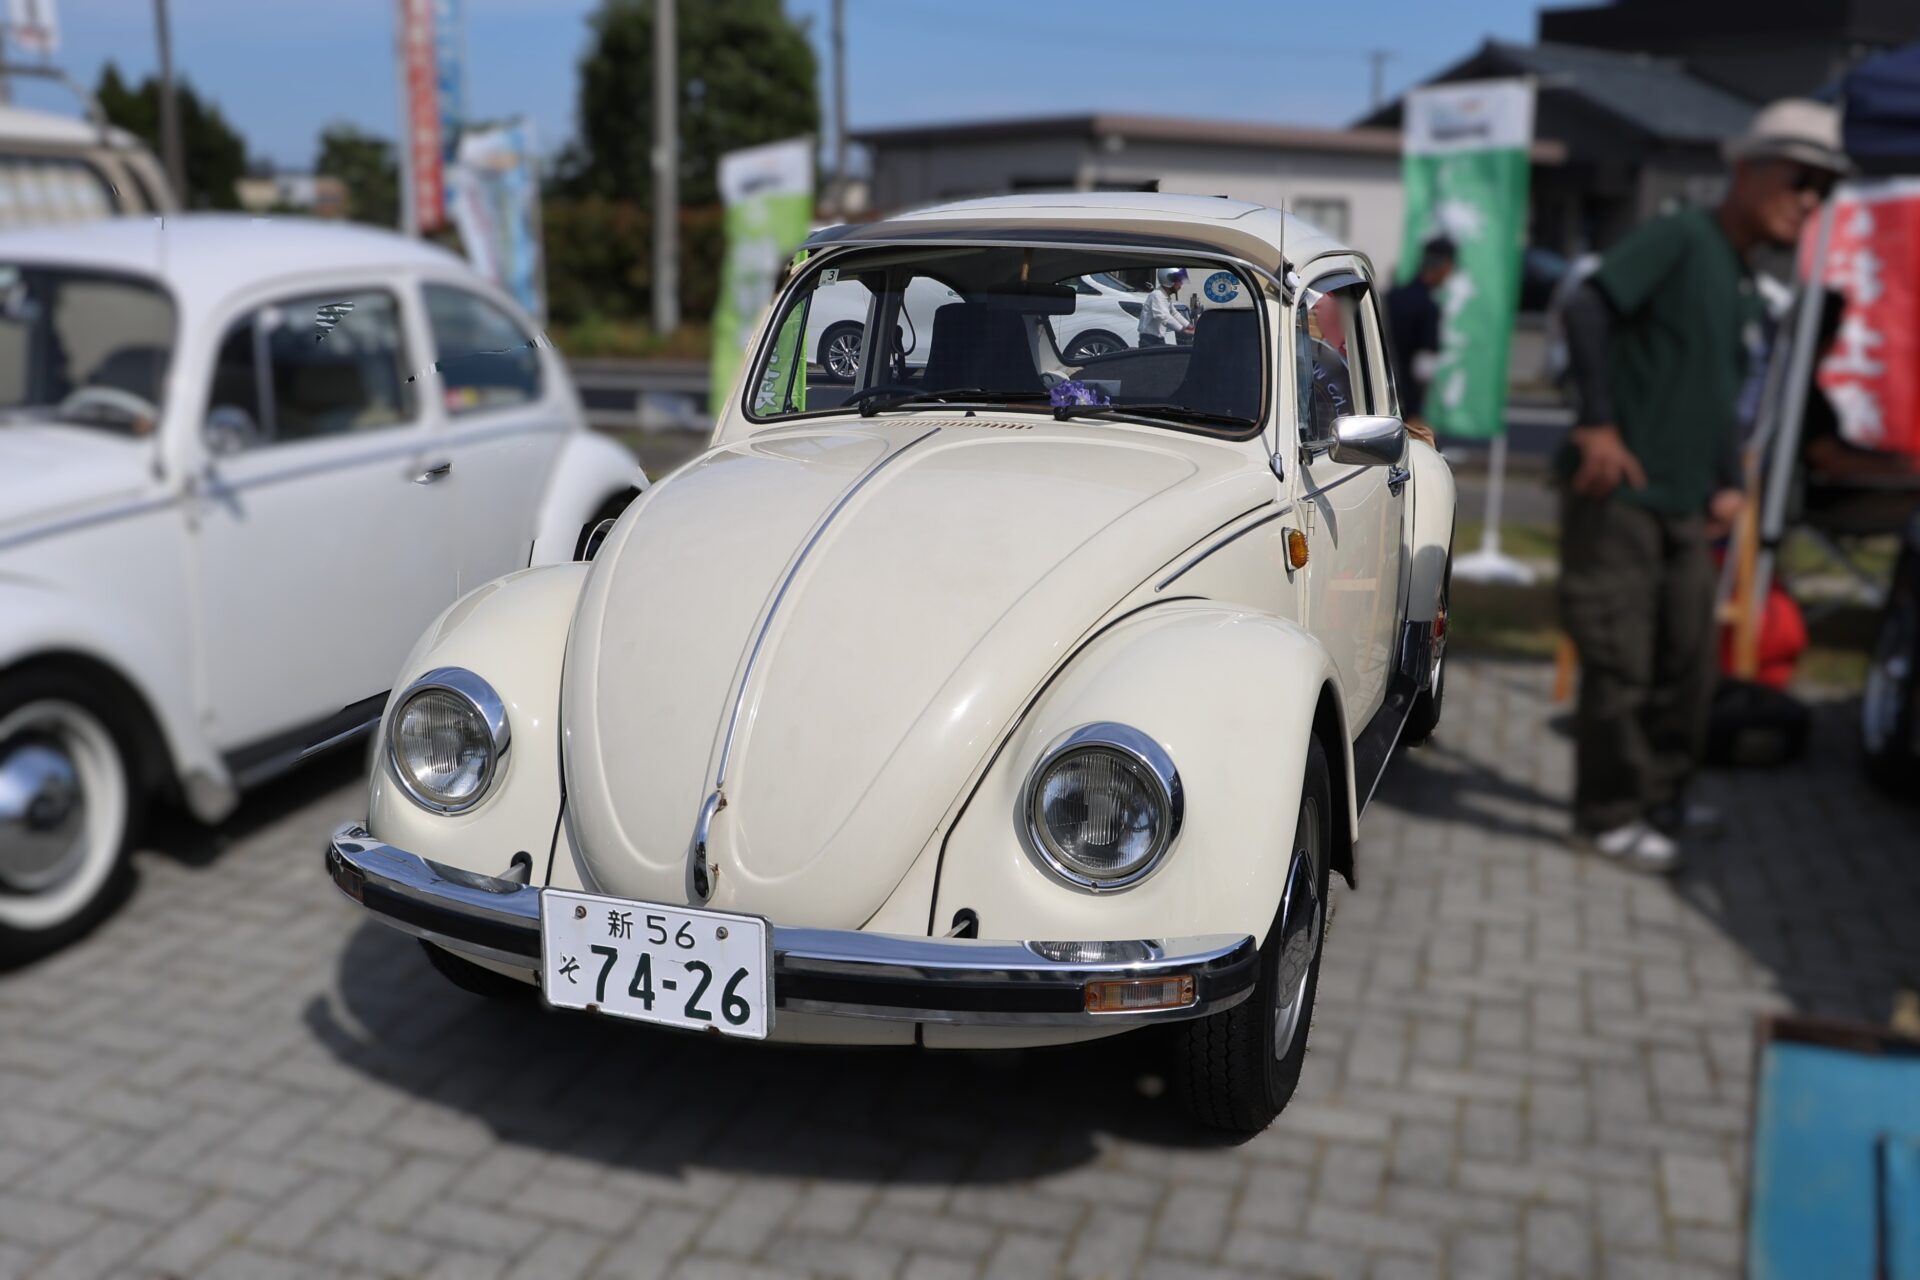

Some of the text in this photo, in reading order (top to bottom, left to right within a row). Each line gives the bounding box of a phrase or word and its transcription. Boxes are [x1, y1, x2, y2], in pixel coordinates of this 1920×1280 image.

[828, 271, 835, 281] 3
[607, 909, 696, 950] 新 56
[558, 944, 751, 1026] そ 74-26
